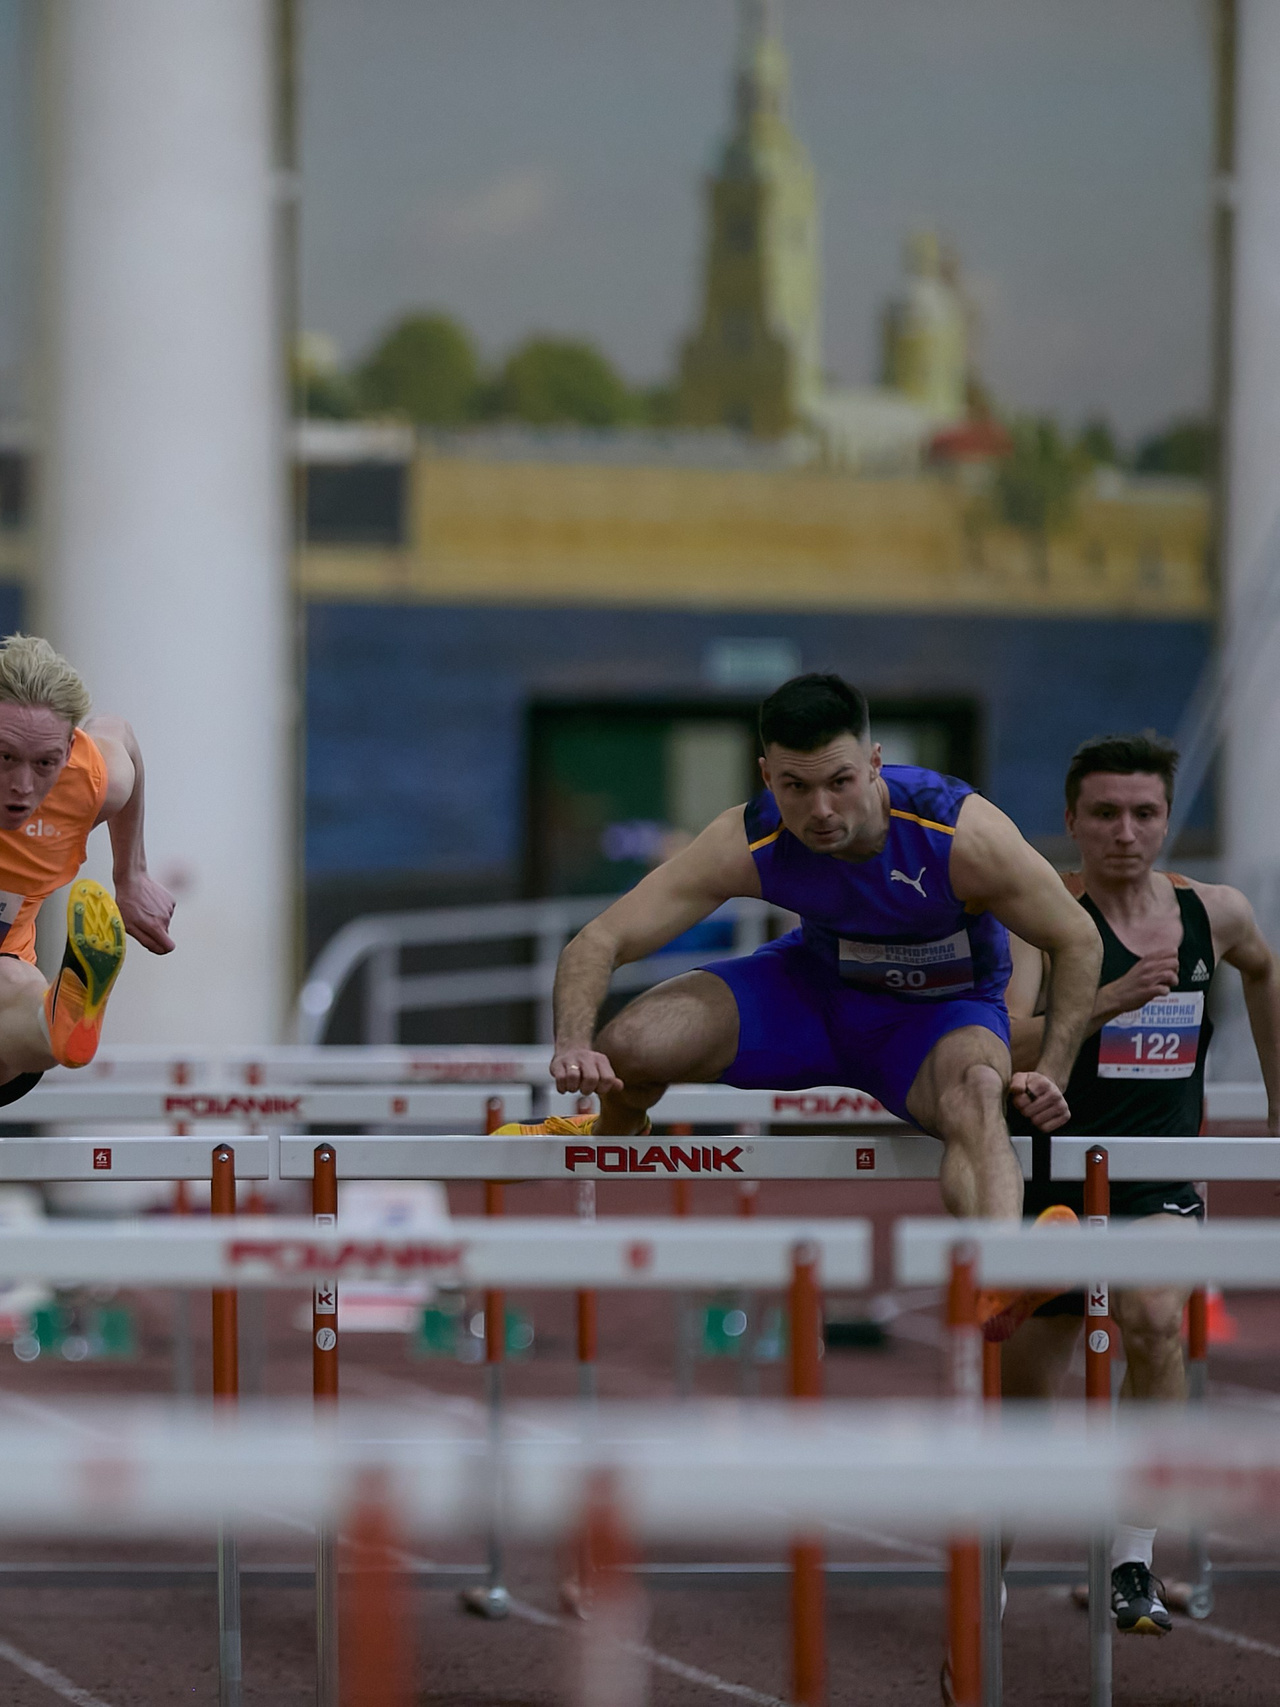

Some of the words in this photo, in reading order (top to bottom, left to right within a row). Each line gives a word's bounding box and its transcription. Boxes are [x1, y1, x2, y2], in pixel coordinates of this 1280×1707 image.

[885, 942, 956, 957] МЕМОРИАЛ
[884, 969, 927, 987] 30
[1141, 1003, 1196, 1016] МЕМОРИАЛ
[1131, 1032, 1180, 1060] 122
[565, 1145, 744, 1173] POLANIK
